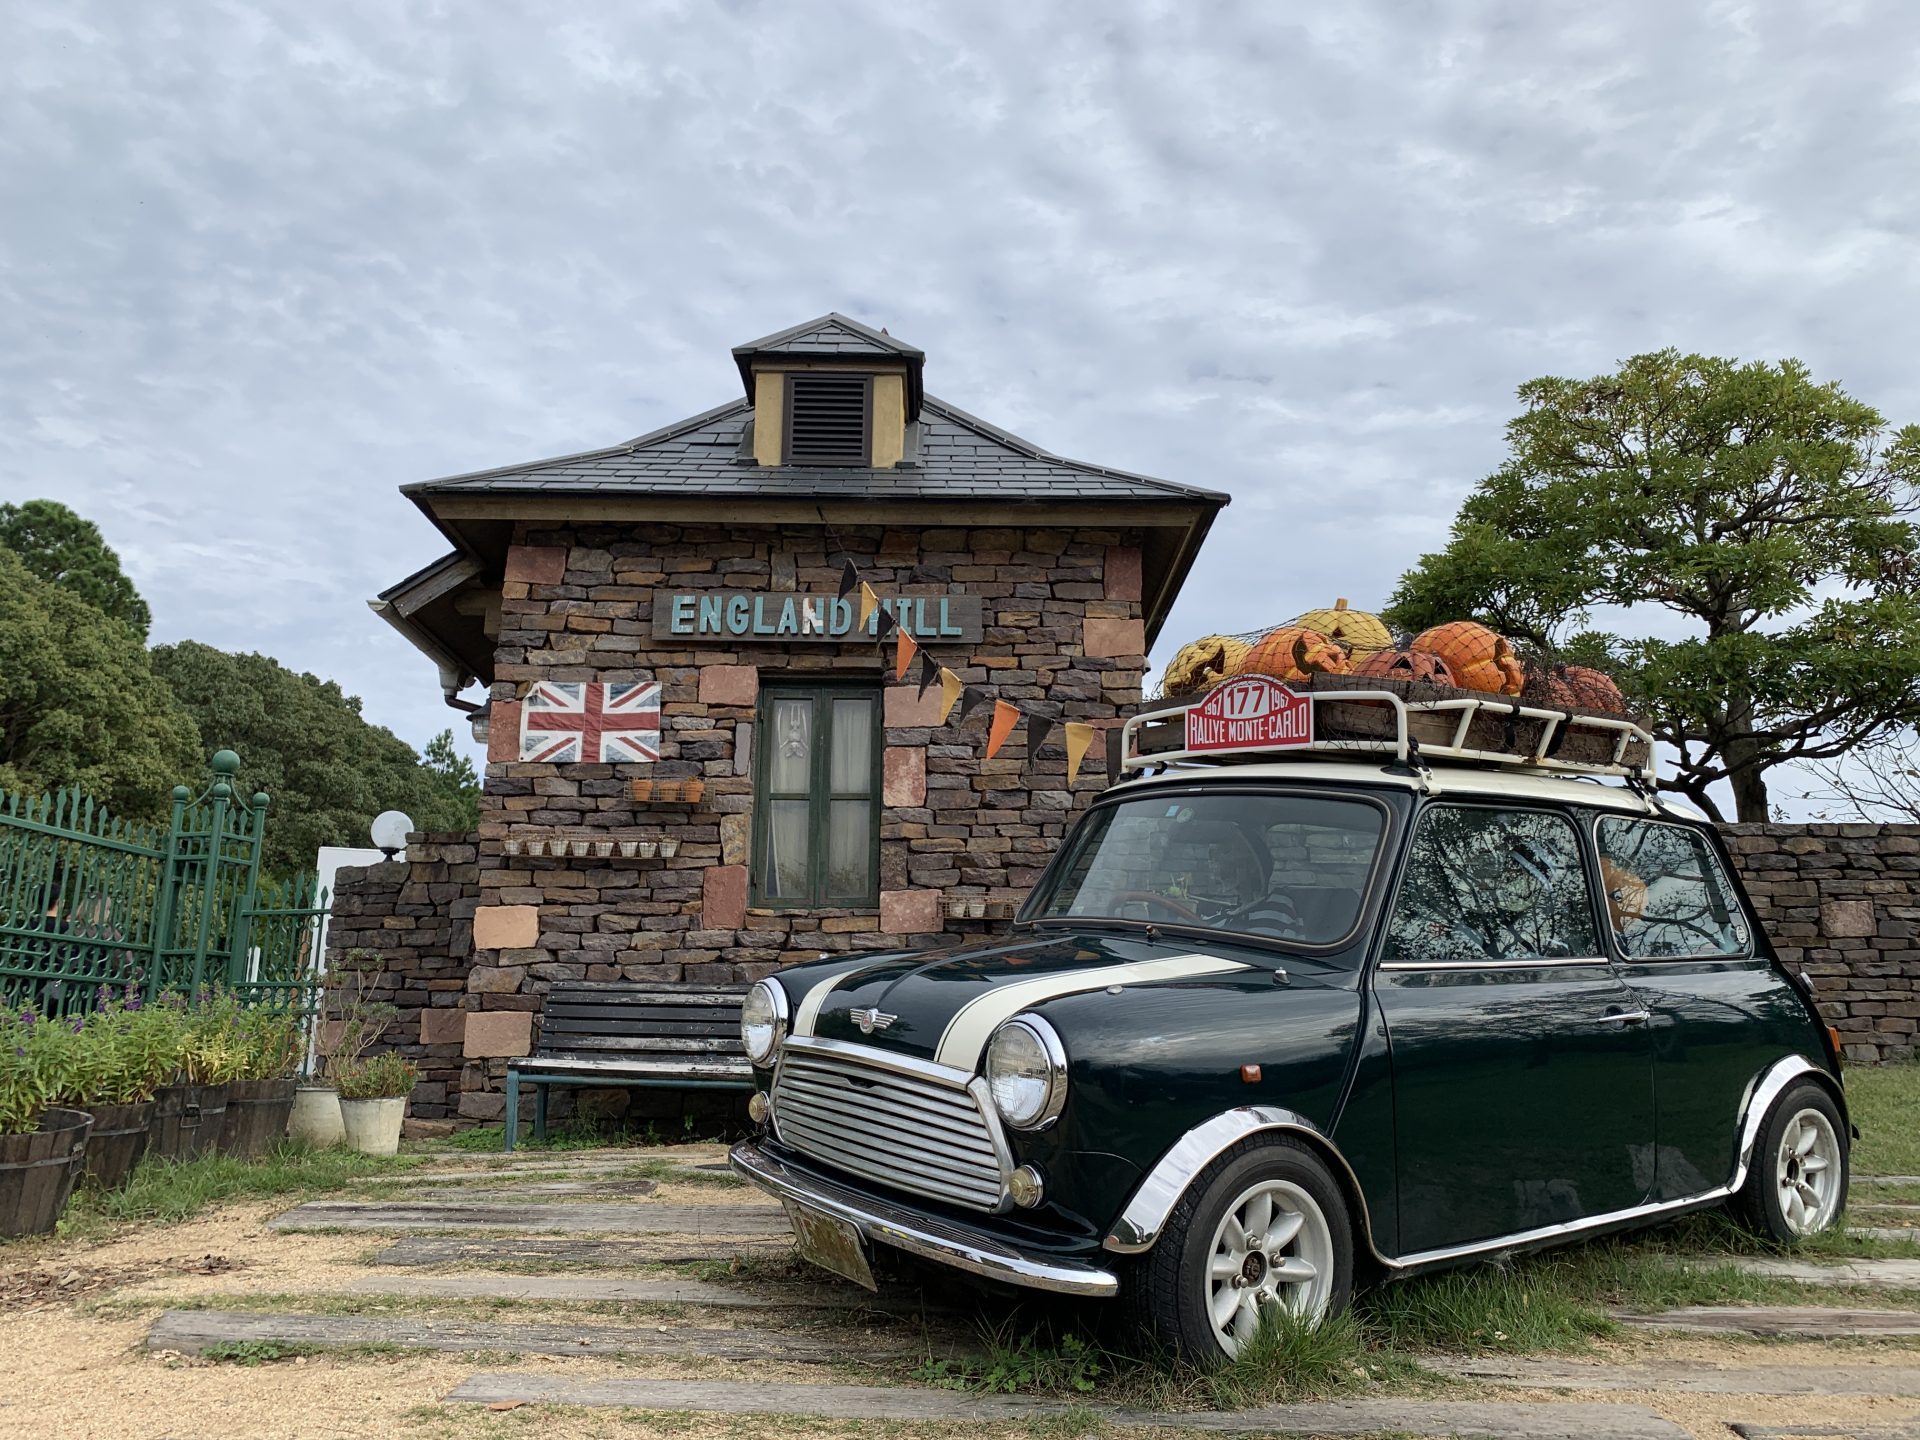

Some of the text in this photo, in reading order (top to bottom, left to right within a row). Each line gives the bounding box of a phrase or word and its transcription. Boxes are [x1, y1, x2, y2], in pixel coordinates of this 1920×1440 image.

[671, 594, 851, 635] ENGLAND
[1204, 685, 1289, 716] 1967 177 1967
[1190, 702, 1307, 745] RALLYE MONTE-CARLO
